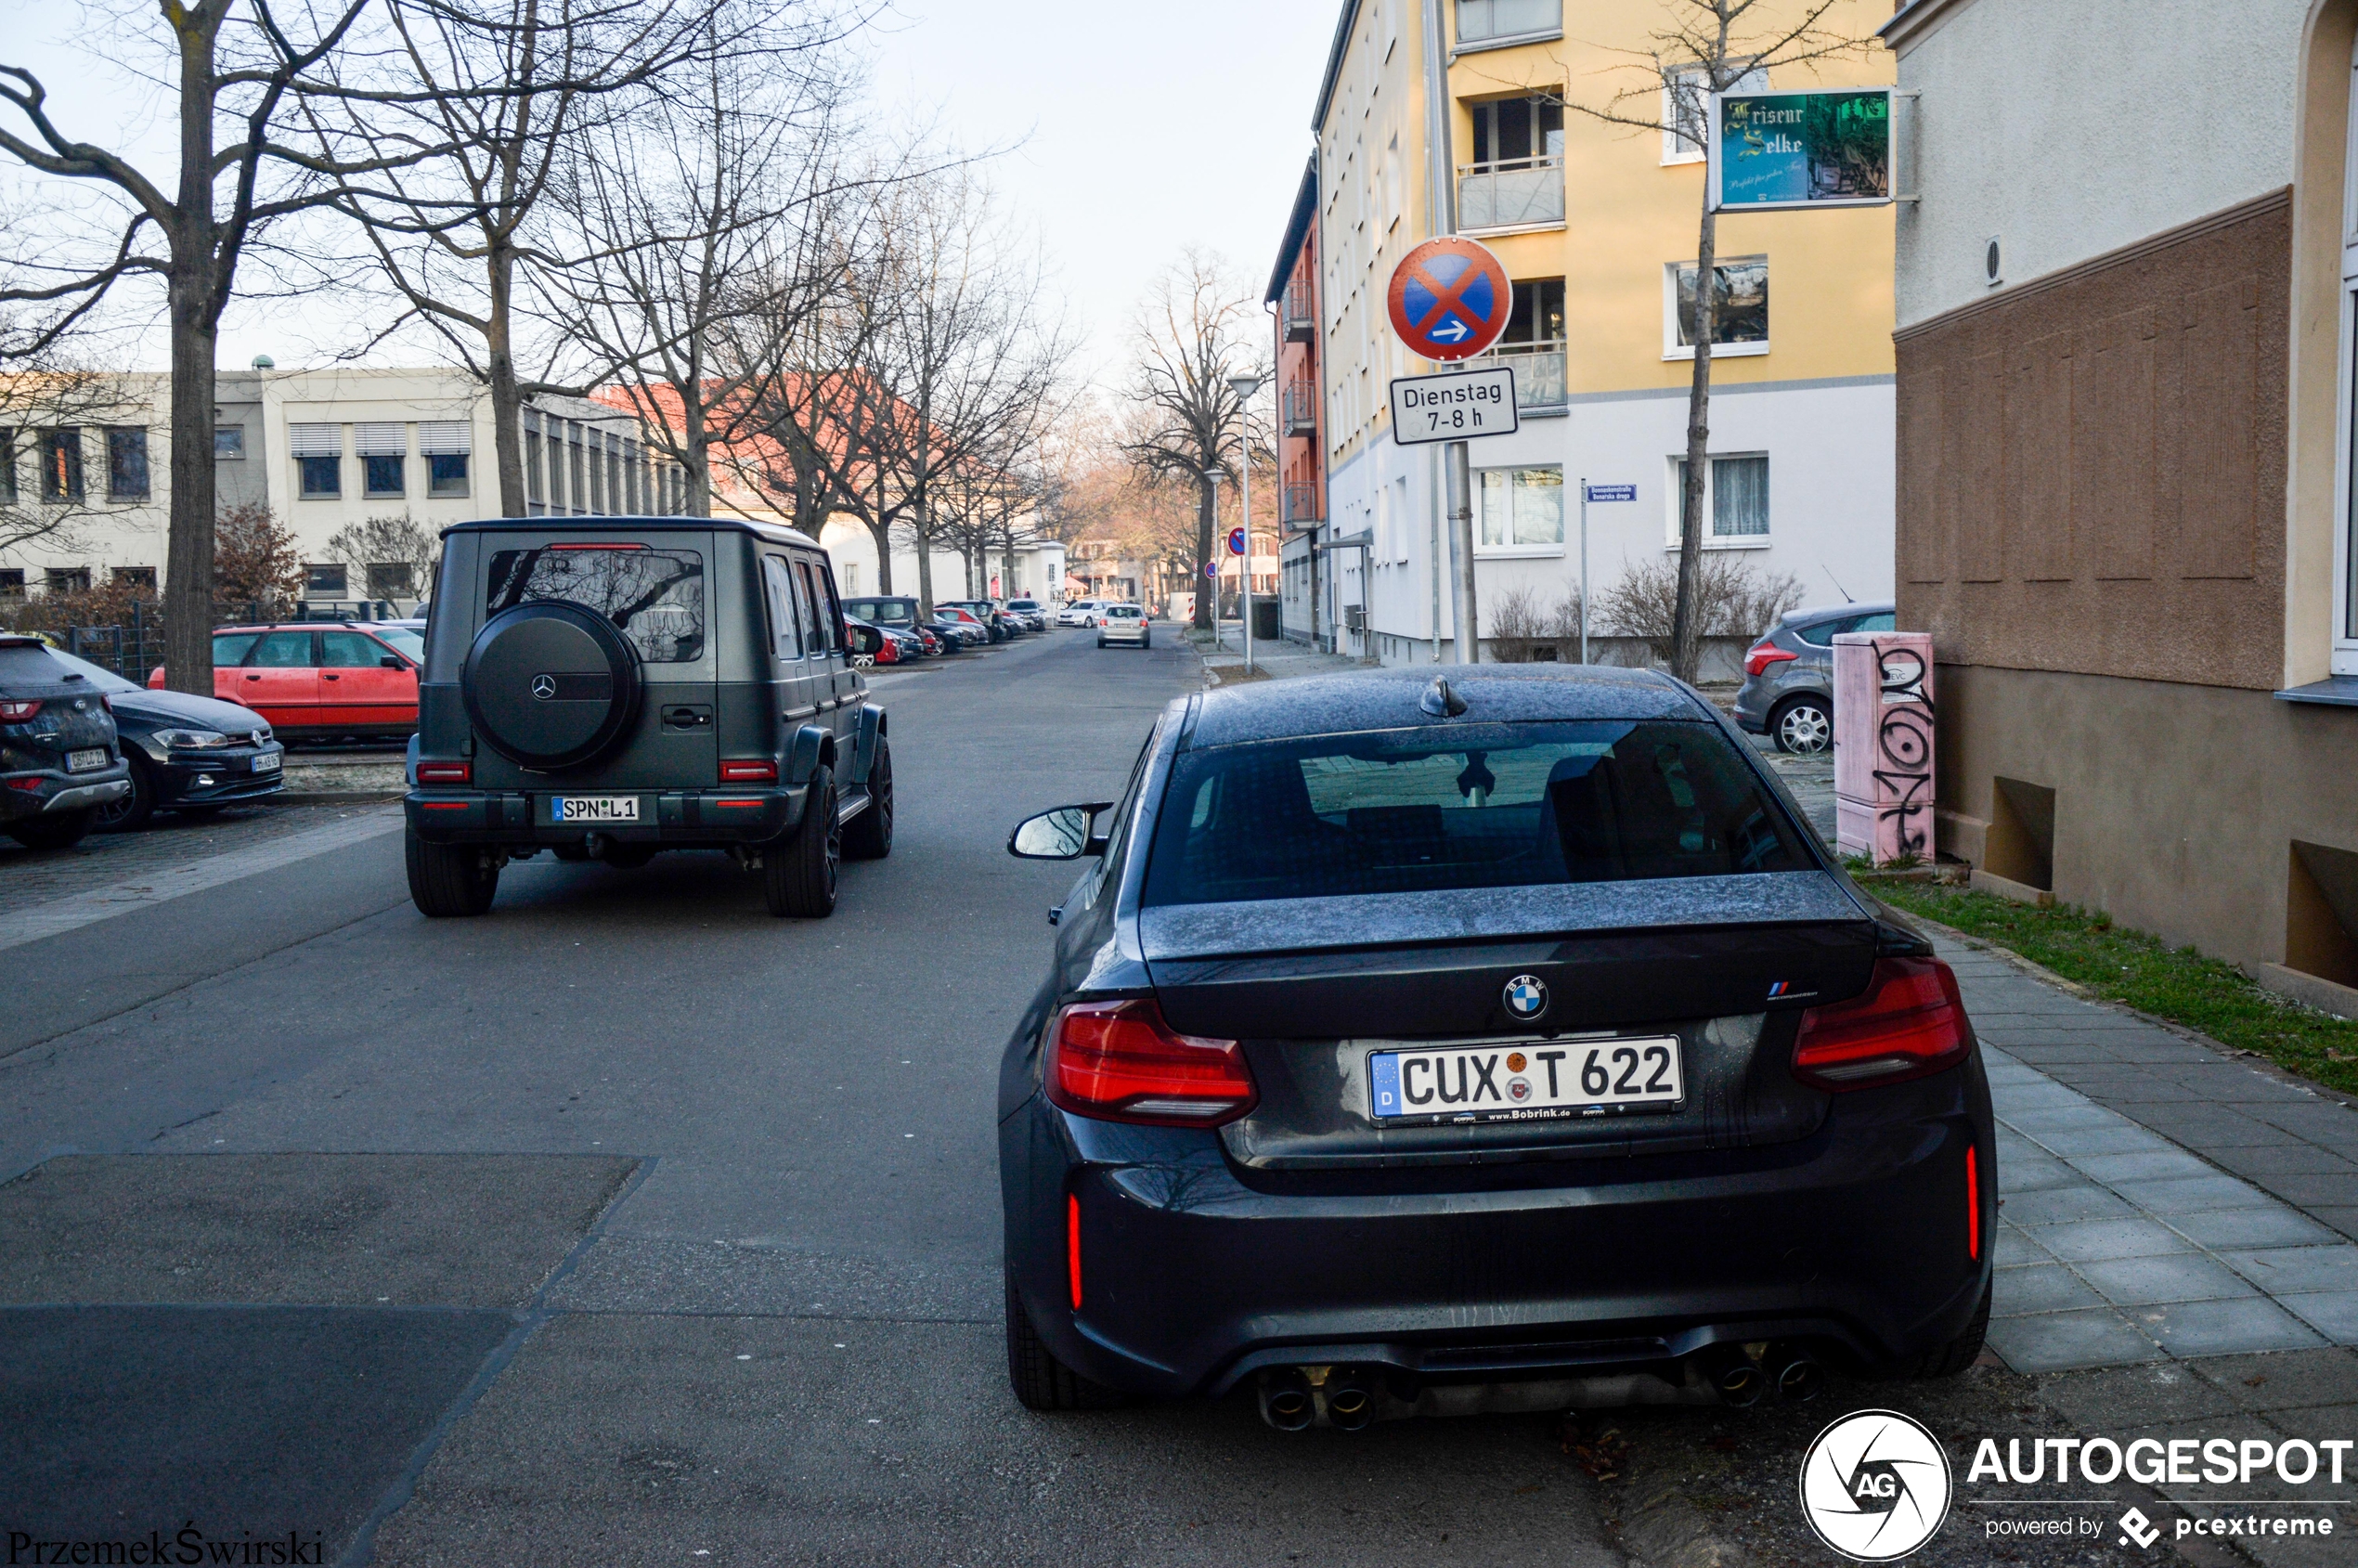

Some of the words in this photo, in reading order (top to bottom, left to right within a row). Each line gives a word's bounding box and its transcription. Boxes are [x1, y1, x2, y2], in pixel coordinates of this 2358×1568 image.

[1729, 101, 1804, 124] Friseur
[1734, 128, 1802, 161] Selke
[1404, 383, 1501, 408] Dienstag
[1428, 409, 1464, 431] 7-8
[1472, 408, 1483, 426] h
[564, 800, 599, 817] SPN
[1509, 977, 1545, 992] BMW
[1403, 1055, 1501, 1105] CUX
[1535, 1051, 1566, 1098] T
[1581, 1046, 1672, 1096] 622
[1380, 1092, 1392, 1106] D
[1488, 1108, 1571, 1121] www.Bobrink.de
